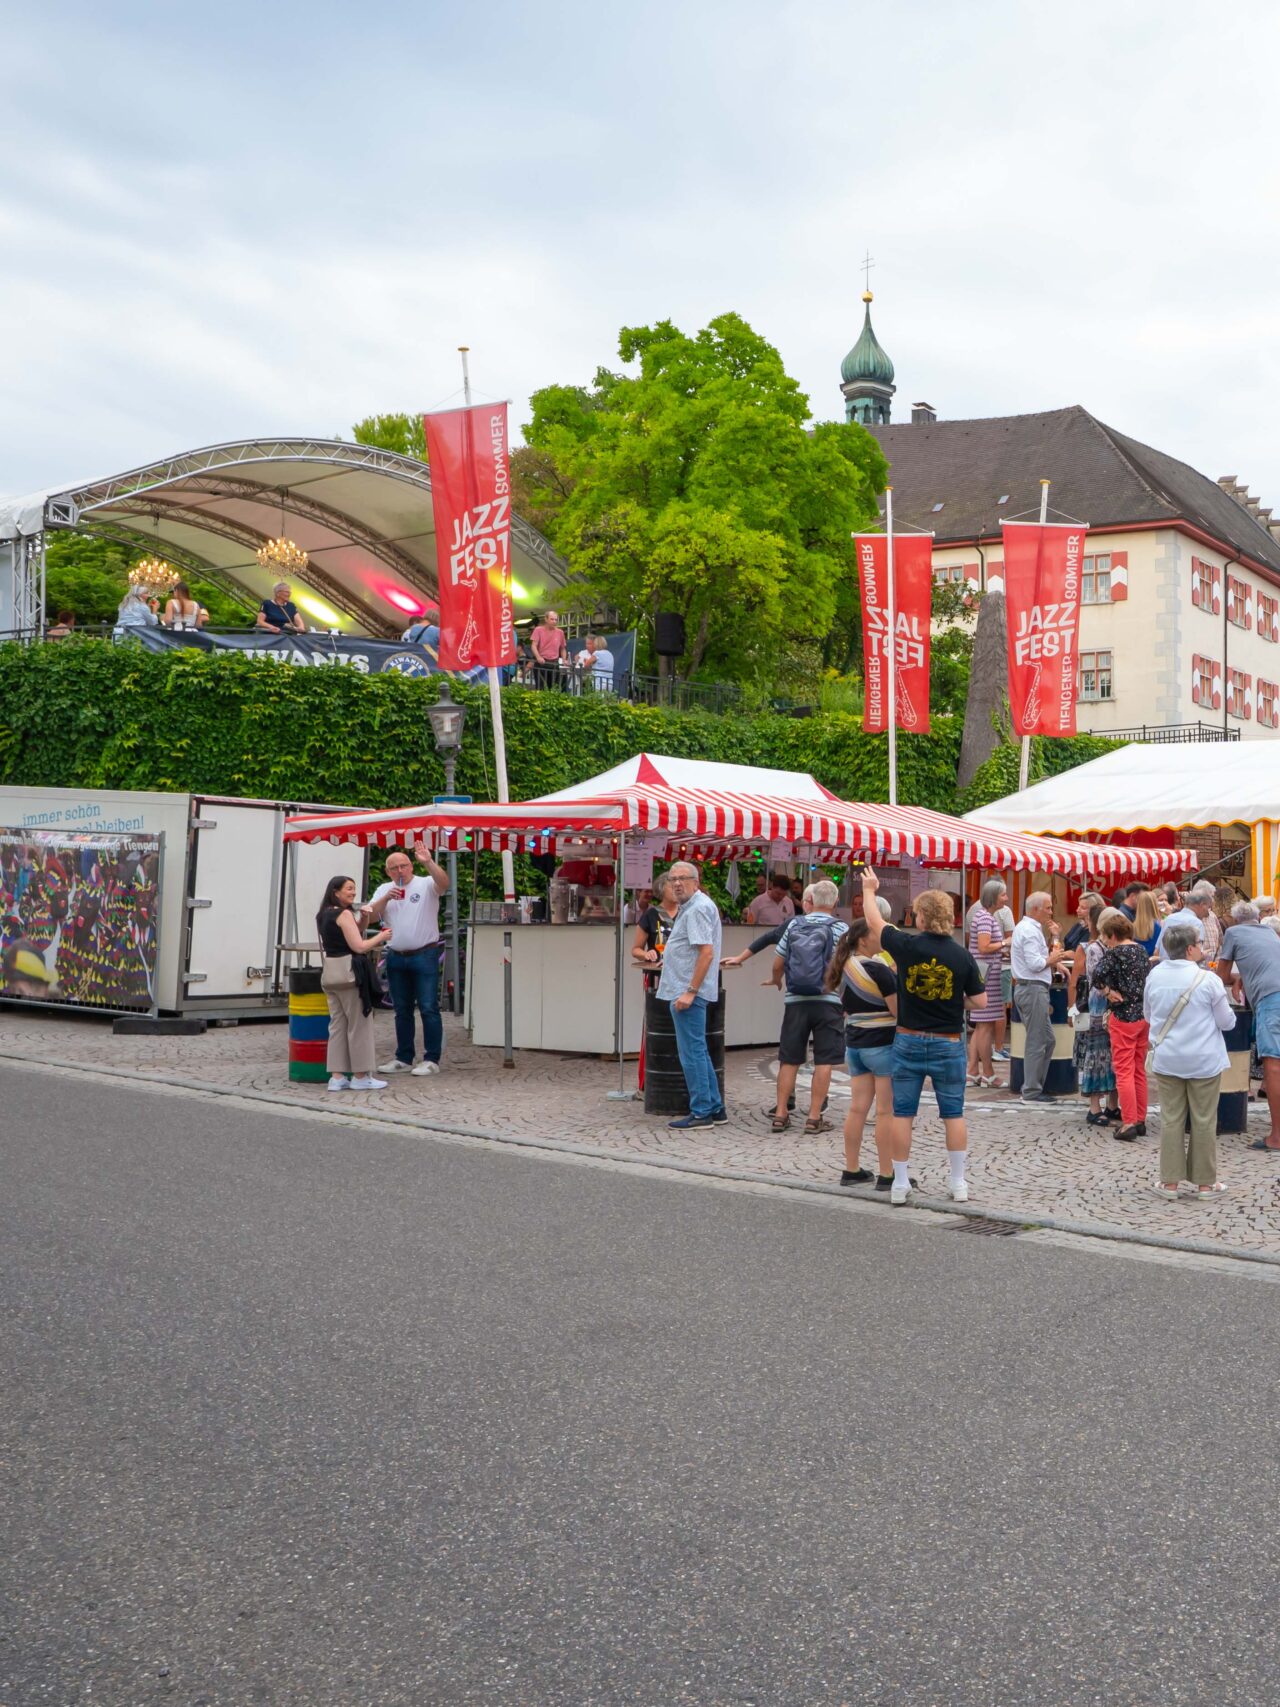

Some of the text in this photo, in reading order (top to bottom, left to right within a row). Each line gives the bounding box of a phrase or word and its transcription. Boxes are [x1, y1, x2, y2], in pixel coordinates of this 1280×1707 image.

[490, 414, 508, 494] SOMMER
[451, 496, 509, 550] JAZZ
[451, 531, 508, 585] FEST
[1065, 535, 1079, 600] SOMMER
[1016, 601, 1077, 637] JAZZ
[390, 656, 424, 670] KIWANIS
[1015, 629, 1075, 666] FEST
[1060, 654, 1072, 731] TIENGENER
[65, 804, 100, 820] schön
[124, 838, 158, 854] Tiengen
